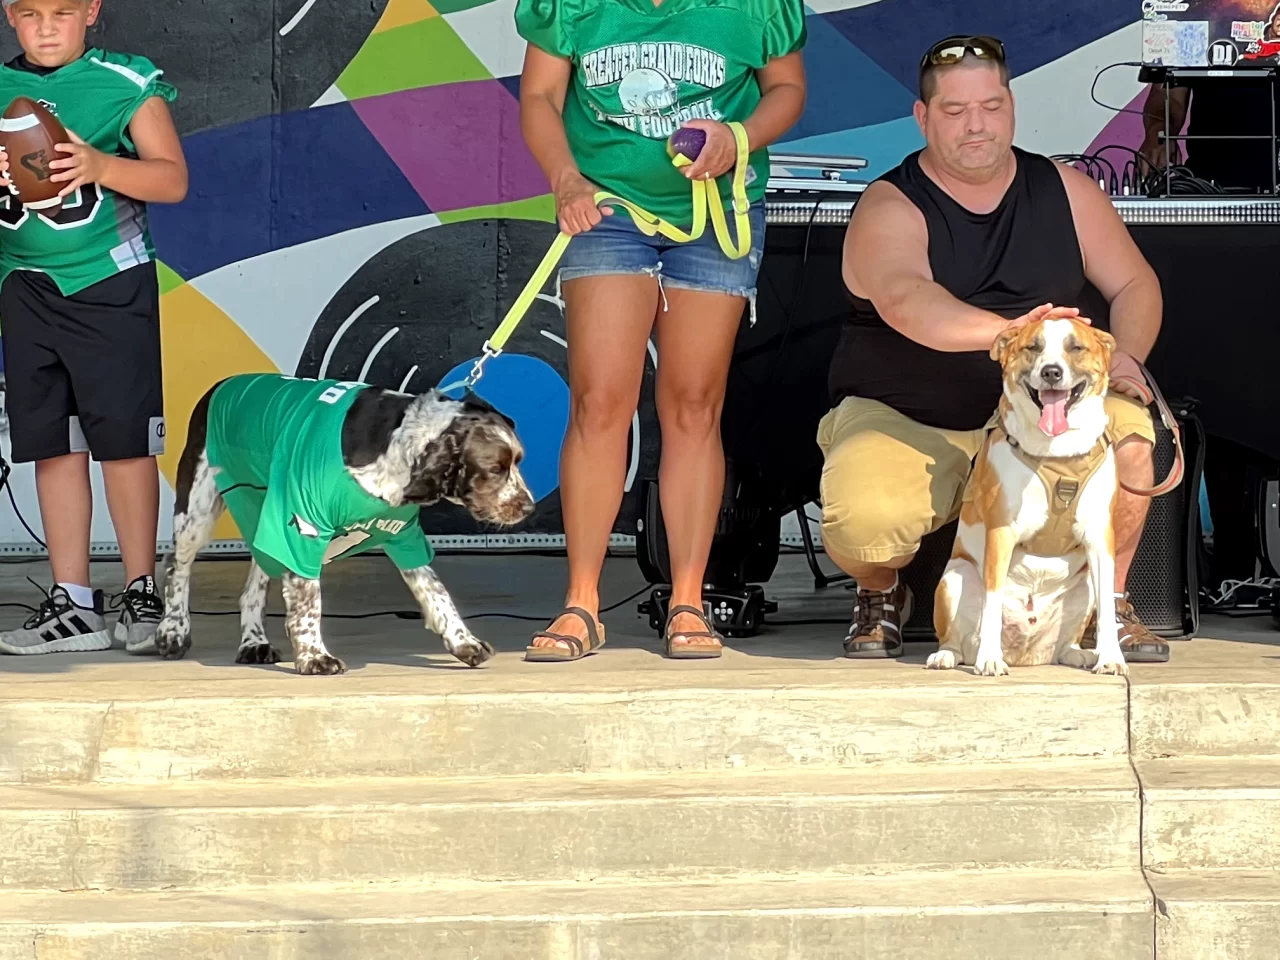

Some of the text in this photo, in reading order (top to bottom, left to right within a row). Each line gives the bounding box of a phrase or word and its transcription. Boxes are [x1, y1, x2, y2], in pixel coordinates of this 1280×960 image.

[582, 42, 726, 89] GREATER GRAND FORKS
